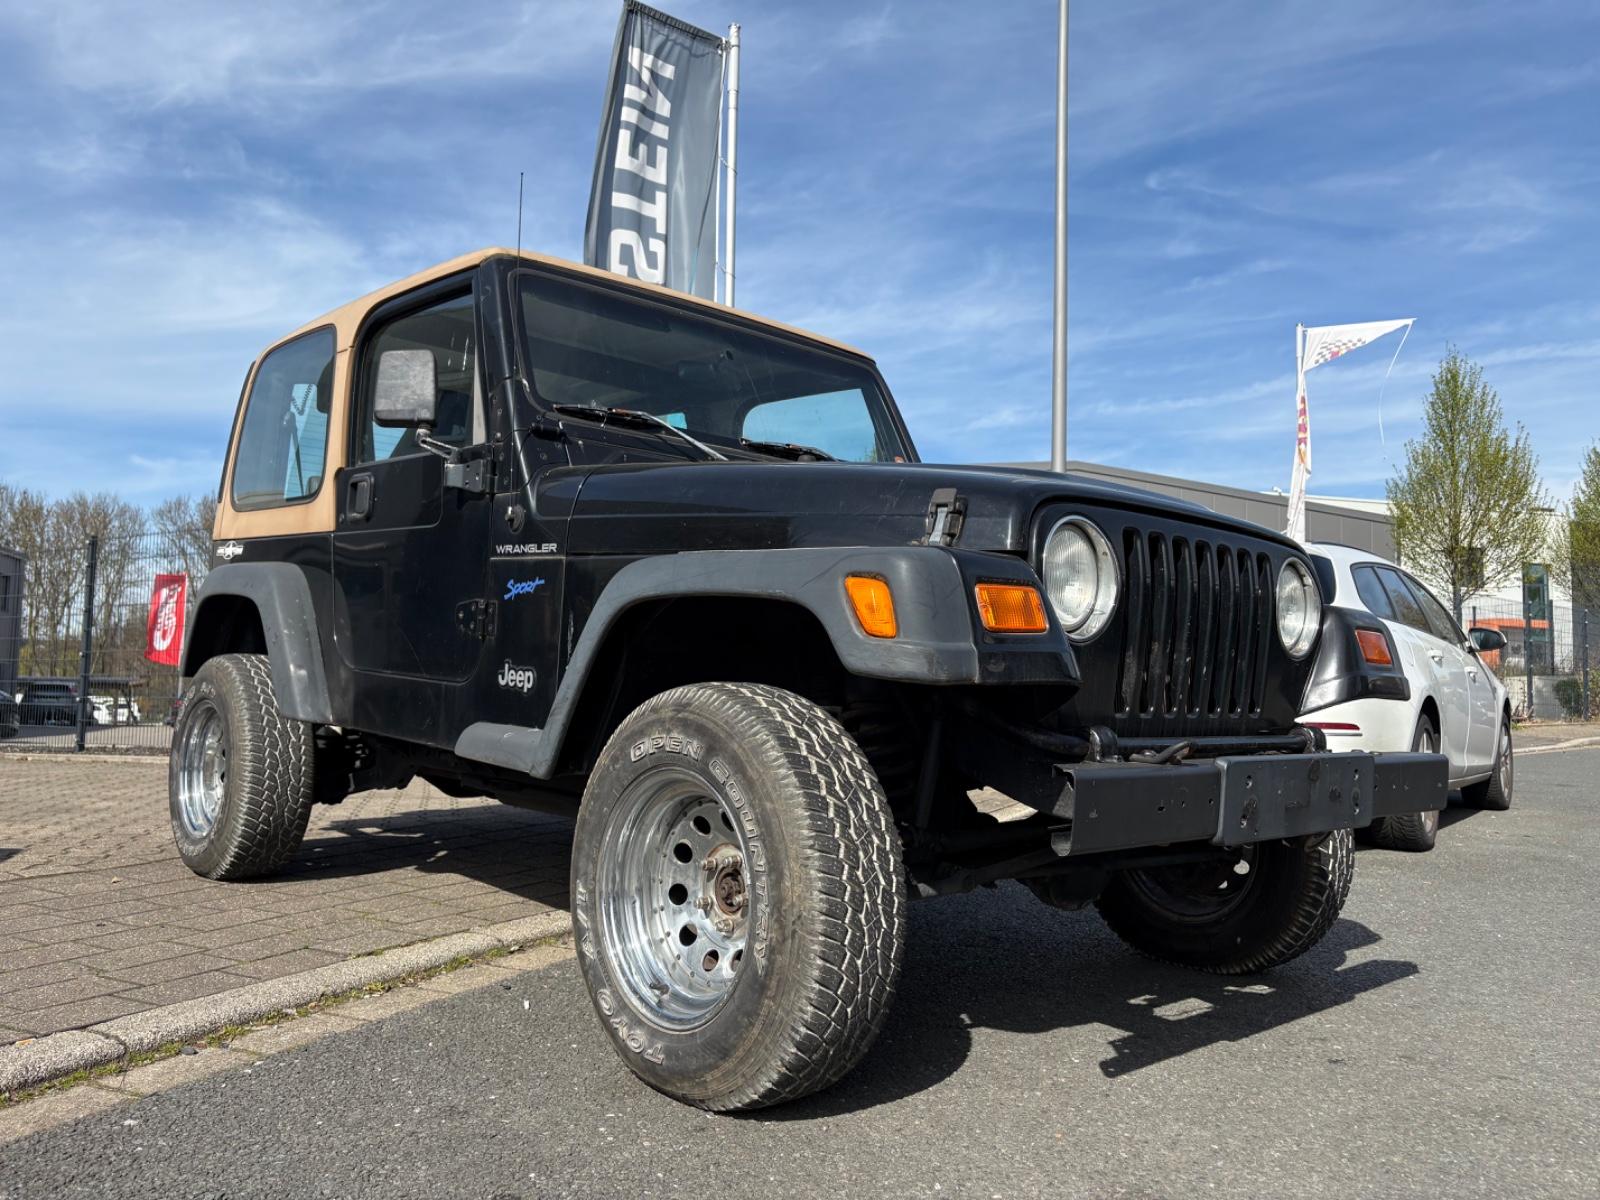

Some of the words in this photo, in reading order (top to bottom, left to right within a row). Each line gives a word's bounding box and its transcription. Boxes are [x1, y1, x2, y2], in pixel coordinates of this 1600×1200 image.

[496, 543, 558, 554] WRANGLER
[498, 662, 534, 693] Jeep
[630, 734, 701, 762] OPEN
[708, 759, 769, 977] COUNTRY
[597, 988, 665, 1066] TOYO
